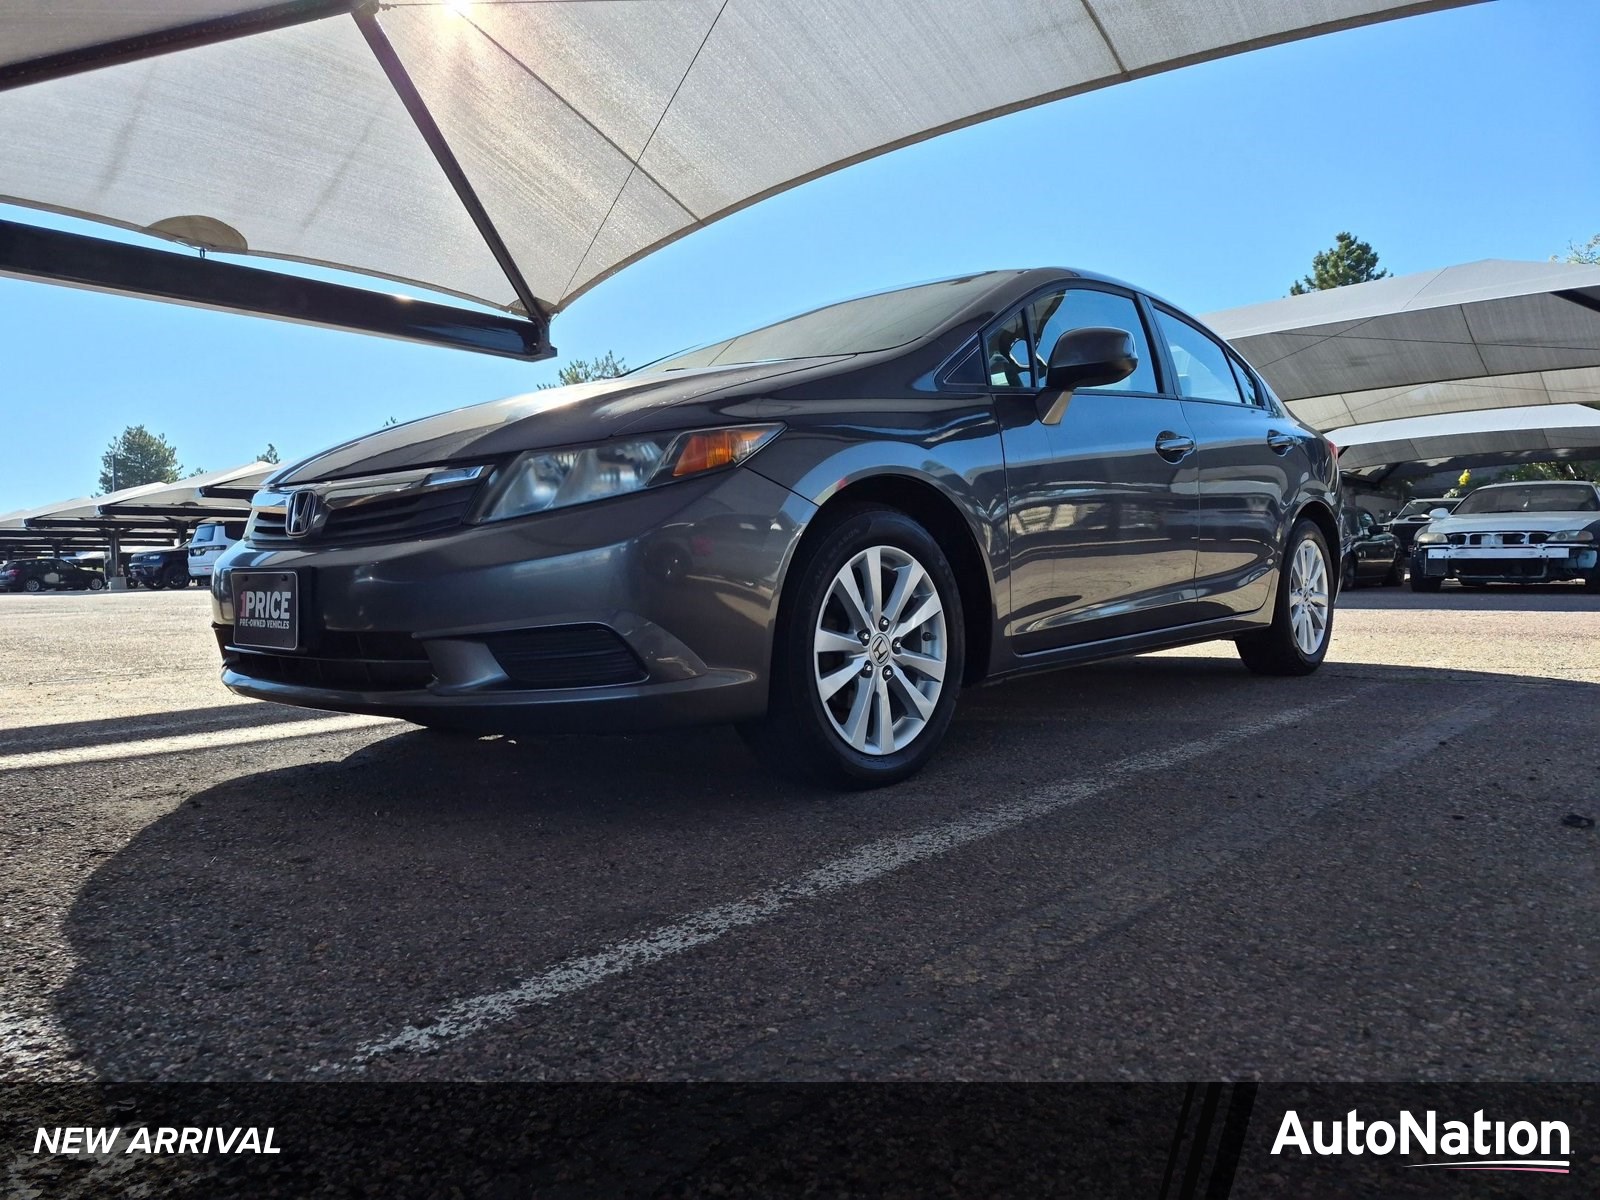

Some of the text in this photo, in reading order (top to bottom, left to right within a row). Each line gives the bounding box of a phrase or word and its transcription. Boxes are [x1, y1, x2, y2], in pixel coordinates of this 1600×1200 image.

[240, 591, 291, 619] 1PRICE
[240, 618, 290, 629] PRE-OWNED VEHICLES
